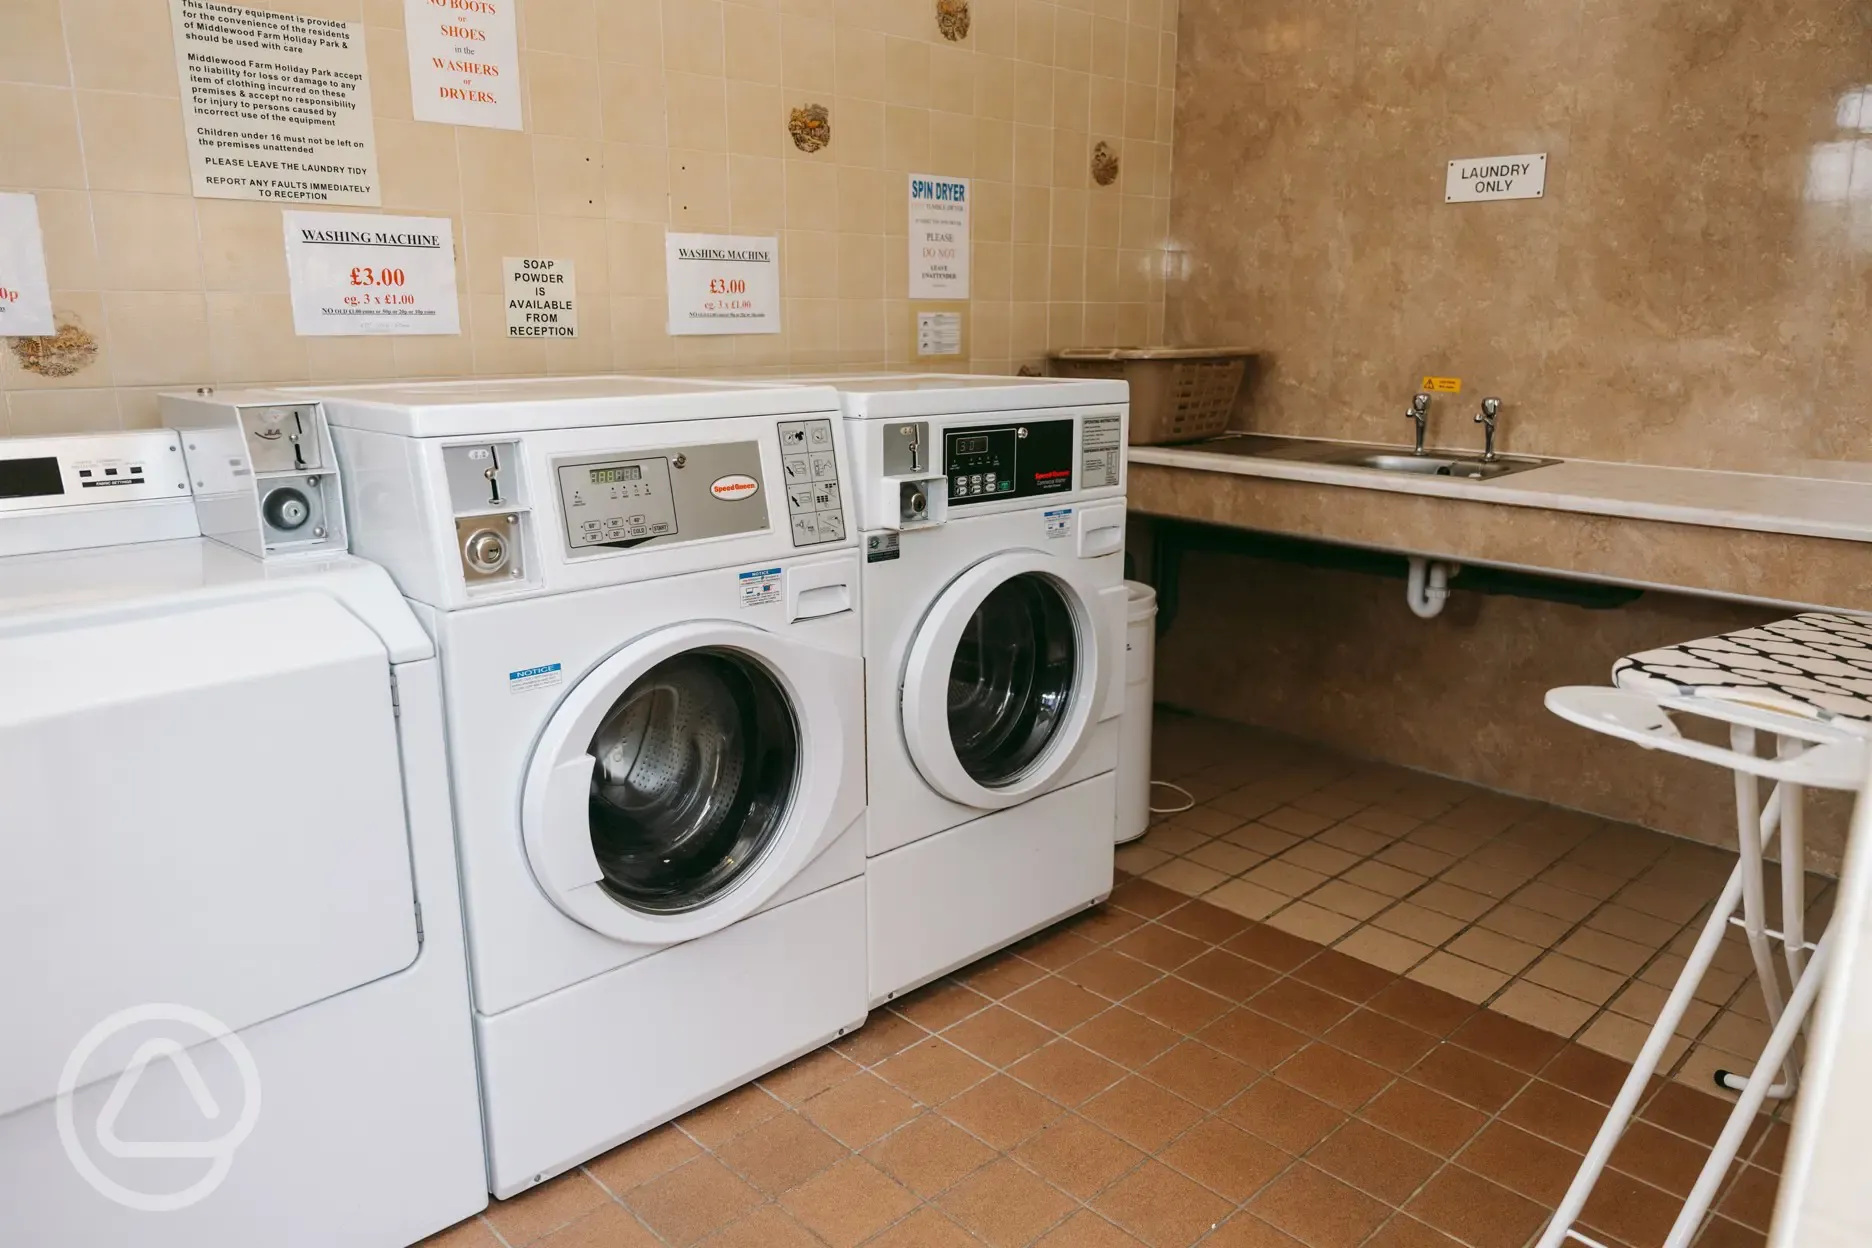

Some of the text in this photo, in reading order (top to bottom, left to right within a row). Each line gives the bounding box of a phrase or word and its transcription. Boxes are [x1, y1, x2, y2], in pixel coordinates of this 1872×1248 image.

[182, 0, 346, 29] This laundry equipment is provided
[451, 0, 496, 15] BOOTS
[183, 10, 196, 18] for
[200, 12, 215, 21] the
[218, 15, 277, 28] convenience
[281, 23, 290, 31] of
[309, 27, 350, 39] residents
[184, 21, 194, 29] of
[197, 23, 254, 36] Middlewood
[258, 31, 280, 40] Farm
[283, 34, 317, 46] Holiday
[320, 39, 339, 48] Park
[186, 32, 219, 42] should
[237, 39, 259, 47] used
[262, 42, 280, 50] with
[441, 25, 486, 41] SHOES
[464, 47, 475, 55] the
[188, 53, 362, 81] Middlewood Farm Holiday Park accept
[433, 57, 499, 76] WASHERS
[204, 66, 240, 77] liability
[243, 69, 256, 77] for
[259, 72, 279, 80] loss
[293, 75, 327, 87] damage
[330, 80, 339, 88] to
[191, 75, 211, 83] item
[215, 77, 224, 85] of
[227, 78, 265, 90] clothing
[268, 83, 306, 94] incurred
[322, 89, 346, 98] these
[192, 86, 236, 97] premises
[249, 92, 279, 102] accept
[296, 97, 356, 110] responsibility
[440, 87, 497, 103] DRYERS.
[193, 96, 207, 104] for
[210, 98, 237, 108] injury
[253, 103, 290, 113] persons
[293, 106, 324, 116] caused
[327, 109, 337, 118] by
[194, 107, 335, 126] incorrect use of the equipment
[197, 128, 238, 138] Children
[242, 132, 268, 140] under
[284, 135, 306, 144] must
[308, 137, 321, 145] not
[337, 139, 351, 147] left
[199, 138, 314, 154] the premises unattended
[206, 157, 367, 175] PLEASE LEAVE THE LAUNDRY TIDY
[1462, 164, 1529, 179] LAUNDRY
[206, 176, 371, 193] REPORT ANY FAULTS IMMEDIATELY
[912, 180, 965, 202] SPIN DRYER
[1475, 180, 1513, 193] ONLY
[259, 189, 327, 200] TO RECEPTION
[301, 229, 440, 246] WASHING MACHINE
[926, 233, 953, 242] PLEASE
[679, 249, 769, 260] WASHING MACHINE
[923, 248, 935, 258] DO
[523, 260, 554, 269] SOAP
[350, 267, 405, 287] £3.00
[514, 273, 564, 283] POWDER
[536, 287, 545, 296] IS
[710, 279, 745, 293] £3.00
[344, 296, 360, 306] eg.
[364, 294, 370, 304] 3
[385, 294, 414, 304] £1.00
[509, 300, 572, 310] AVAILABLE
[526, 313, 557, 323] FROM
[510, 326, 574, 336] RECEPTION
[714, 484, 734, 493] Speed
[517, 666, 554, 677] NOTICE
